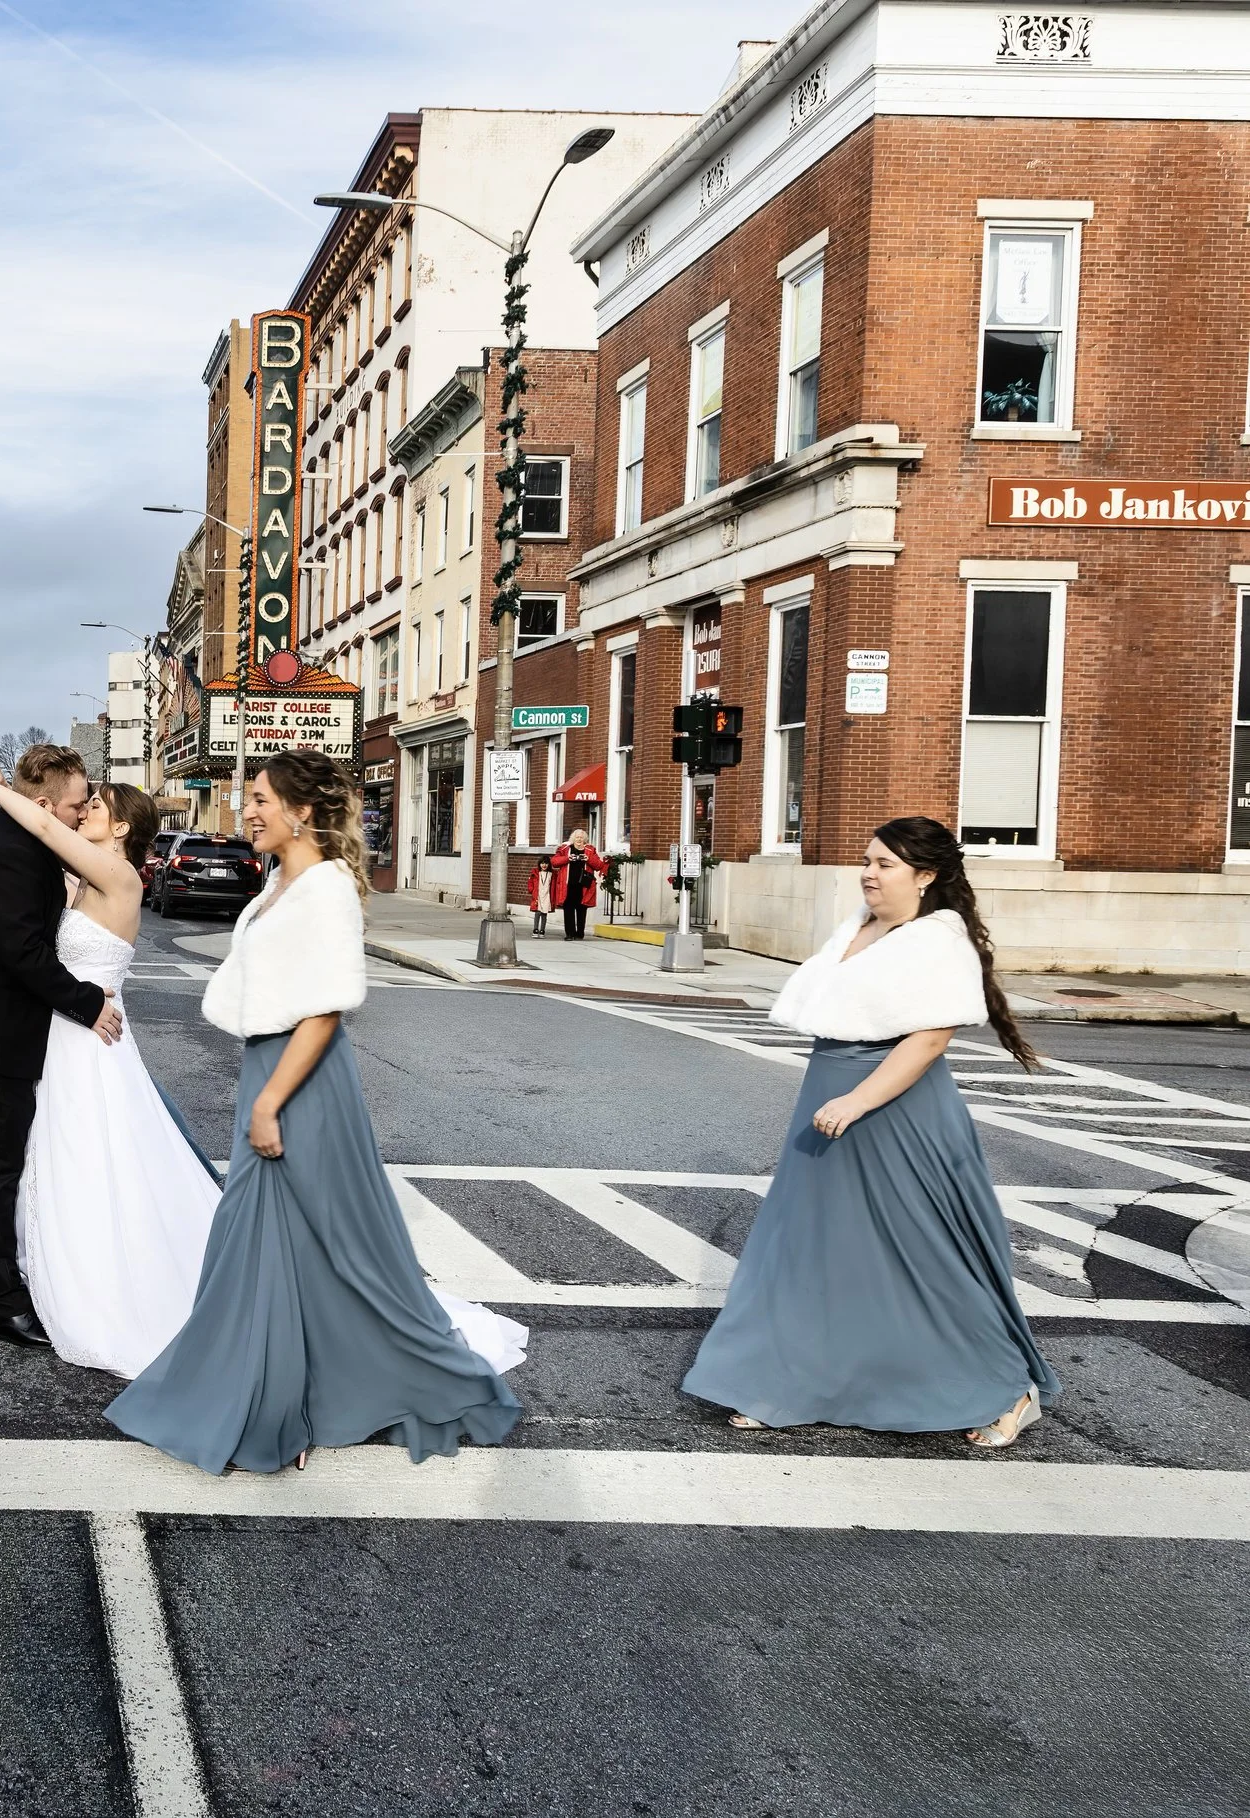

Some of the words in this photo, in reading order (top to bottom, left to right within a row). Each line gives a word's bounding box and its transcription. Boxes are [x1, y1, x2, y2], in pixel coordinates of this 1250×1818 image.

[258, 321, 301, 664] BARDAVON
[1009, 487, 1088, 519] Bob
[694, 622, 708, 646] Bob
[283, 702, 332, 714] COLLEGE
[223, 714, 275, 726] LESONS
[280, 715, 289, 726] &
[295, 716, 341, 727] CAROLS
[519, 710, 566, 725] Cannon
[571, 712, 582, 724] st
[244, 728, 297, 740] ATURDAY
[210, 741, 247, 752] CELTI
[323, 743, 351, 754] 16/17
[575, 792, 598, 801] ATM
